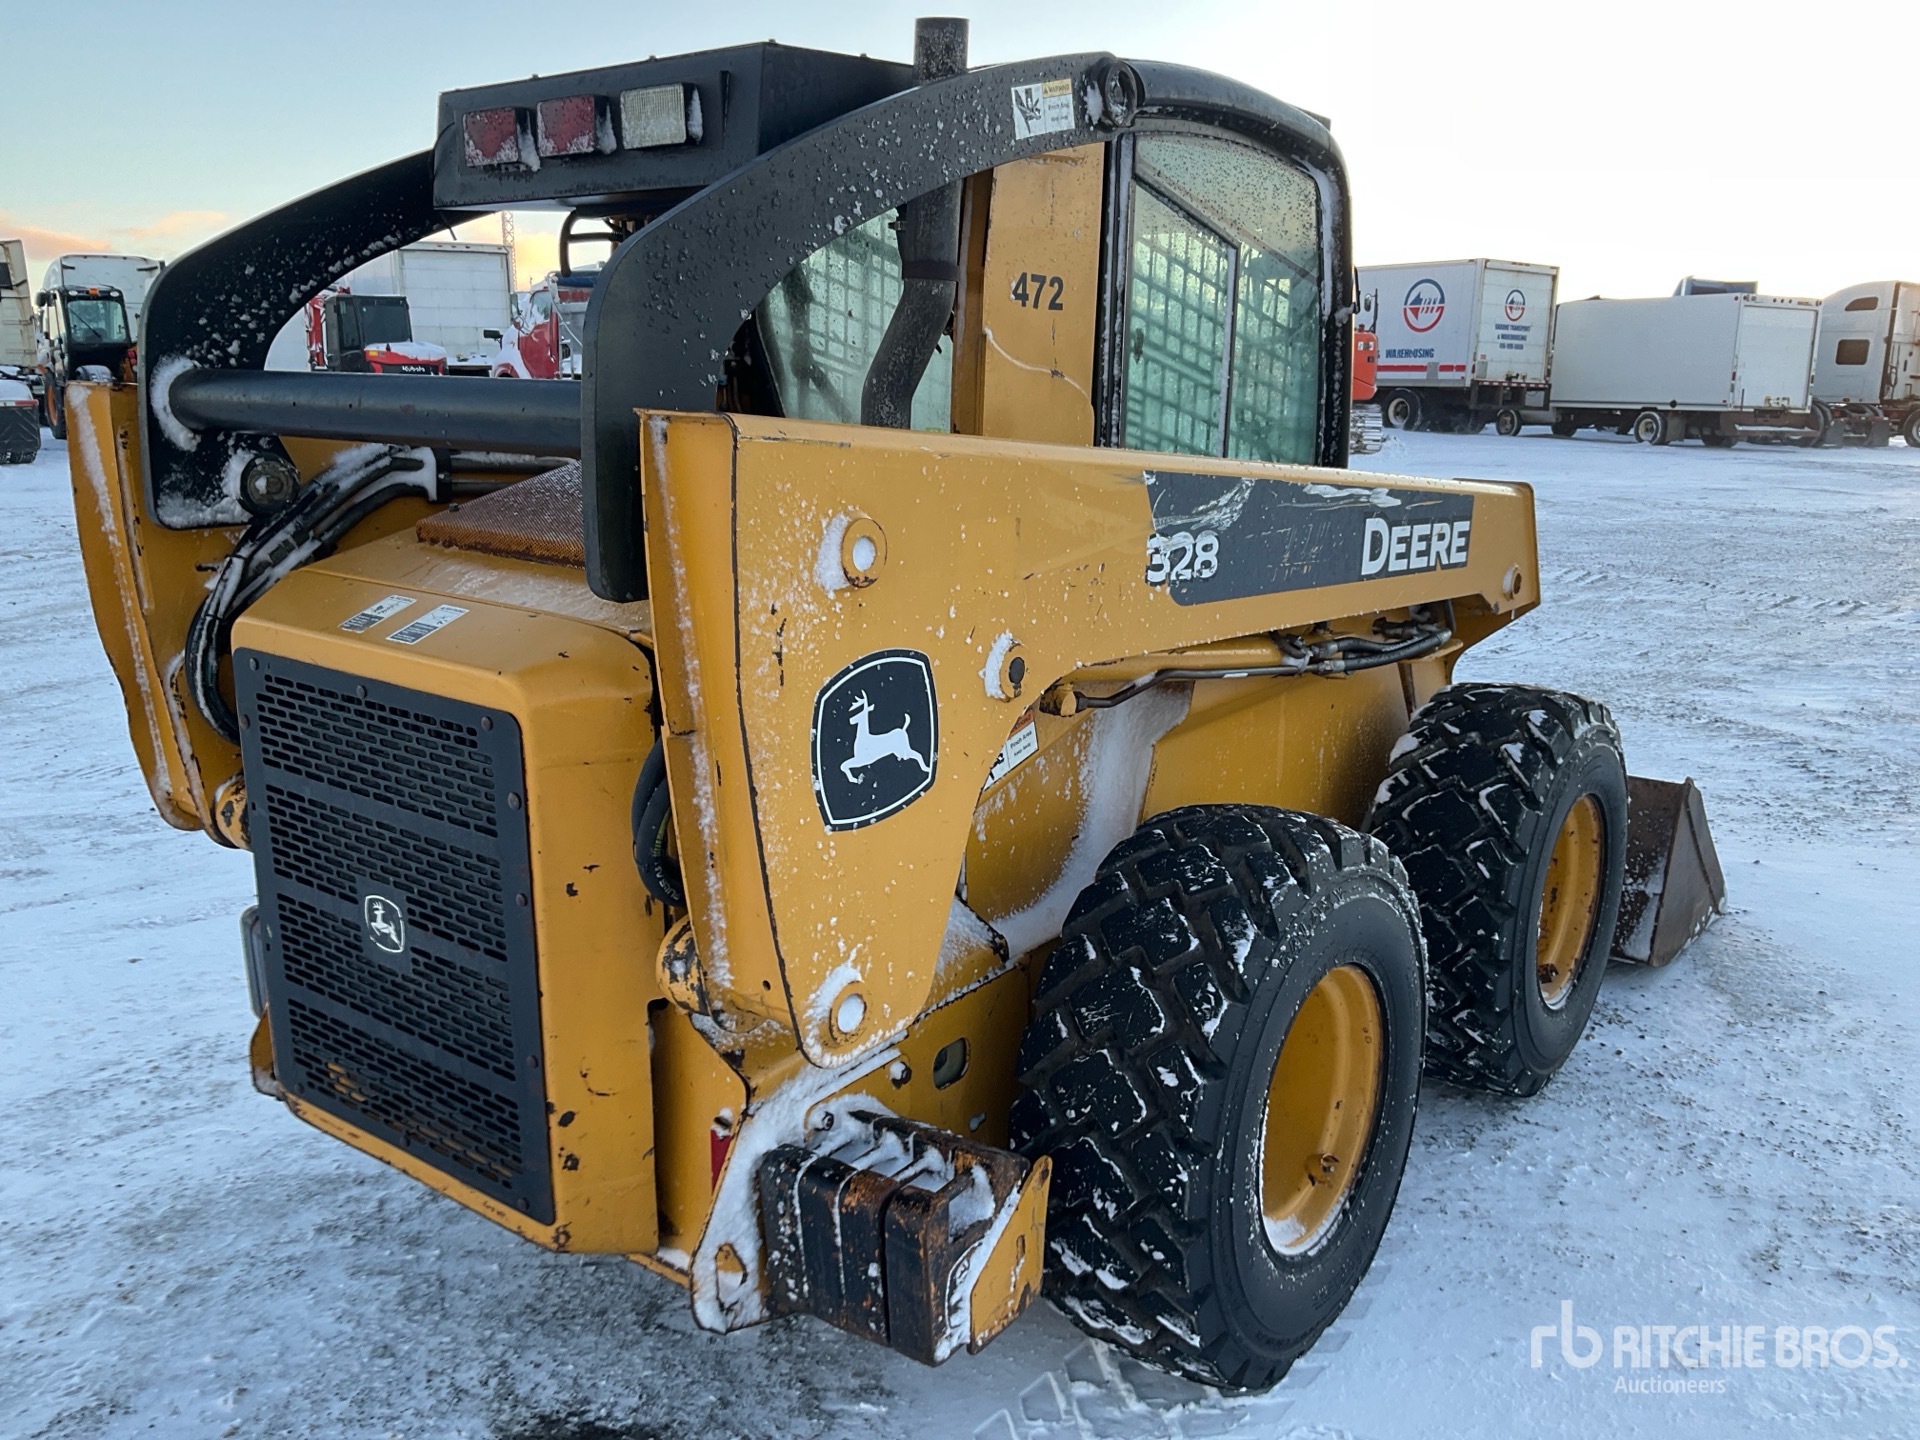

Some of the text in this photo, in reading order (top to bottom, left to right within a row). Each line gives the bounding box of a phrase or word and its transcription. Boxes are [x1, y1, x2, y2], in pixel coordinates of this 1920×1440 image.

[1012, 272, 1064, 311] 472
[1146, 530, 1219, 583] 328
[1361, 517, 1471, 576] DEERE
